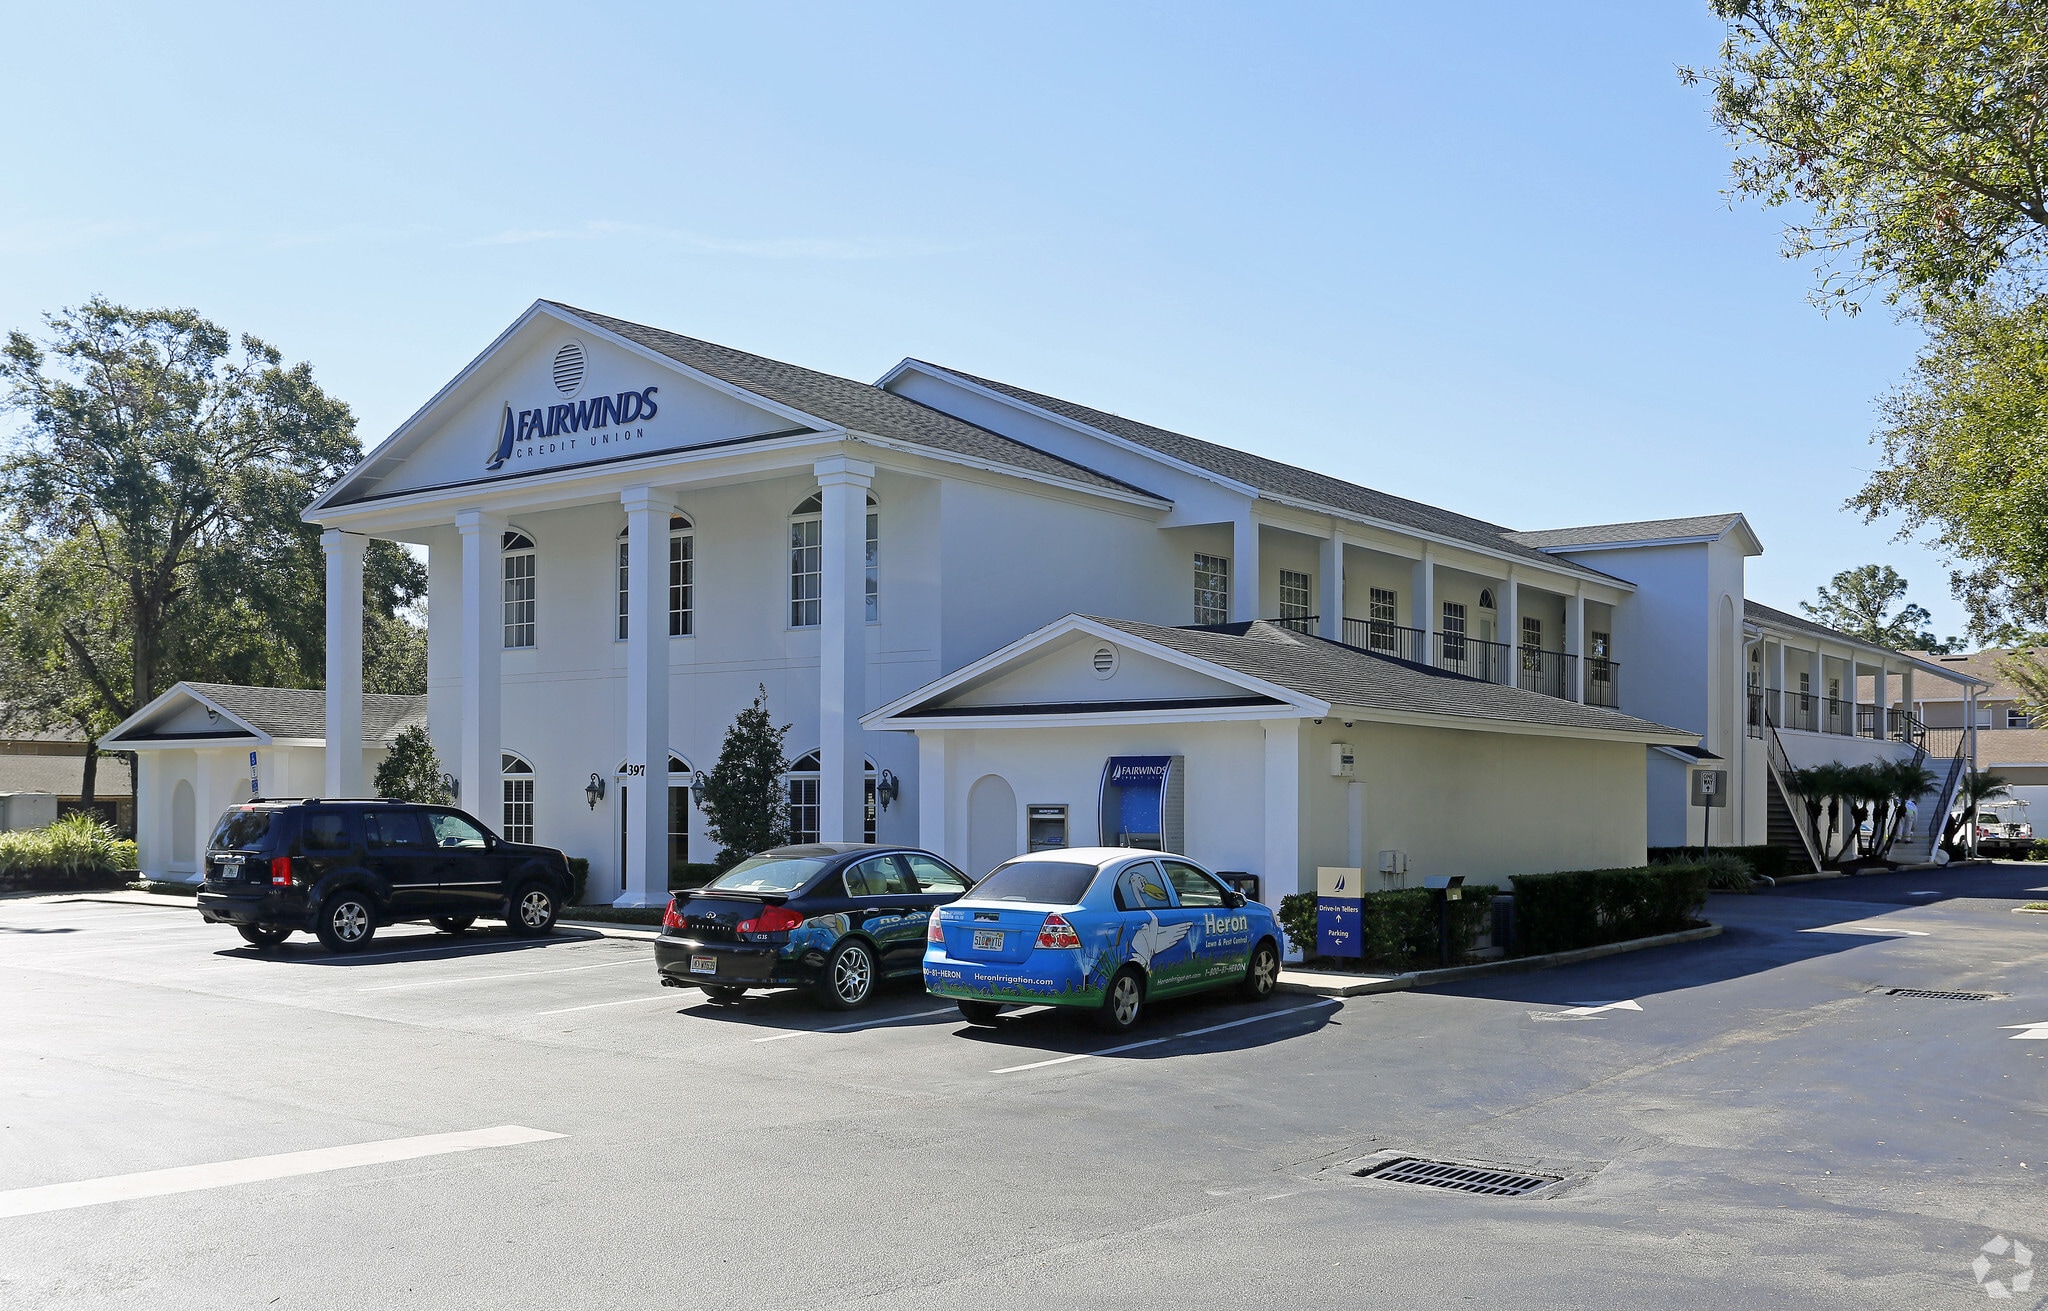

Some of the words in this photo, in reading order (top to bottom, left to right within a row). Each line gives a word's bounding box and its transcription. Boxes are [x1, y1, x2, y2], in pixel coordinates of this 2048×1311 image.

[516, 386, 658, 442] FAIRWINDS
[516, 439, 576, 458] CREDIT
[590, 428, 643, 446] UNION
[627, 764, 645, 776] 397
[1121, 766, 1166, 775] FAIRWINDS
[1204, 913, 1248, 936] Heron
[1328, 929, 1349, 938] Parking
[1205, 940, 1217, 948] Lawn
[1218, 939, 1222, 947] &
[974, 973, 1053, 985] HeronIrrigation.com
